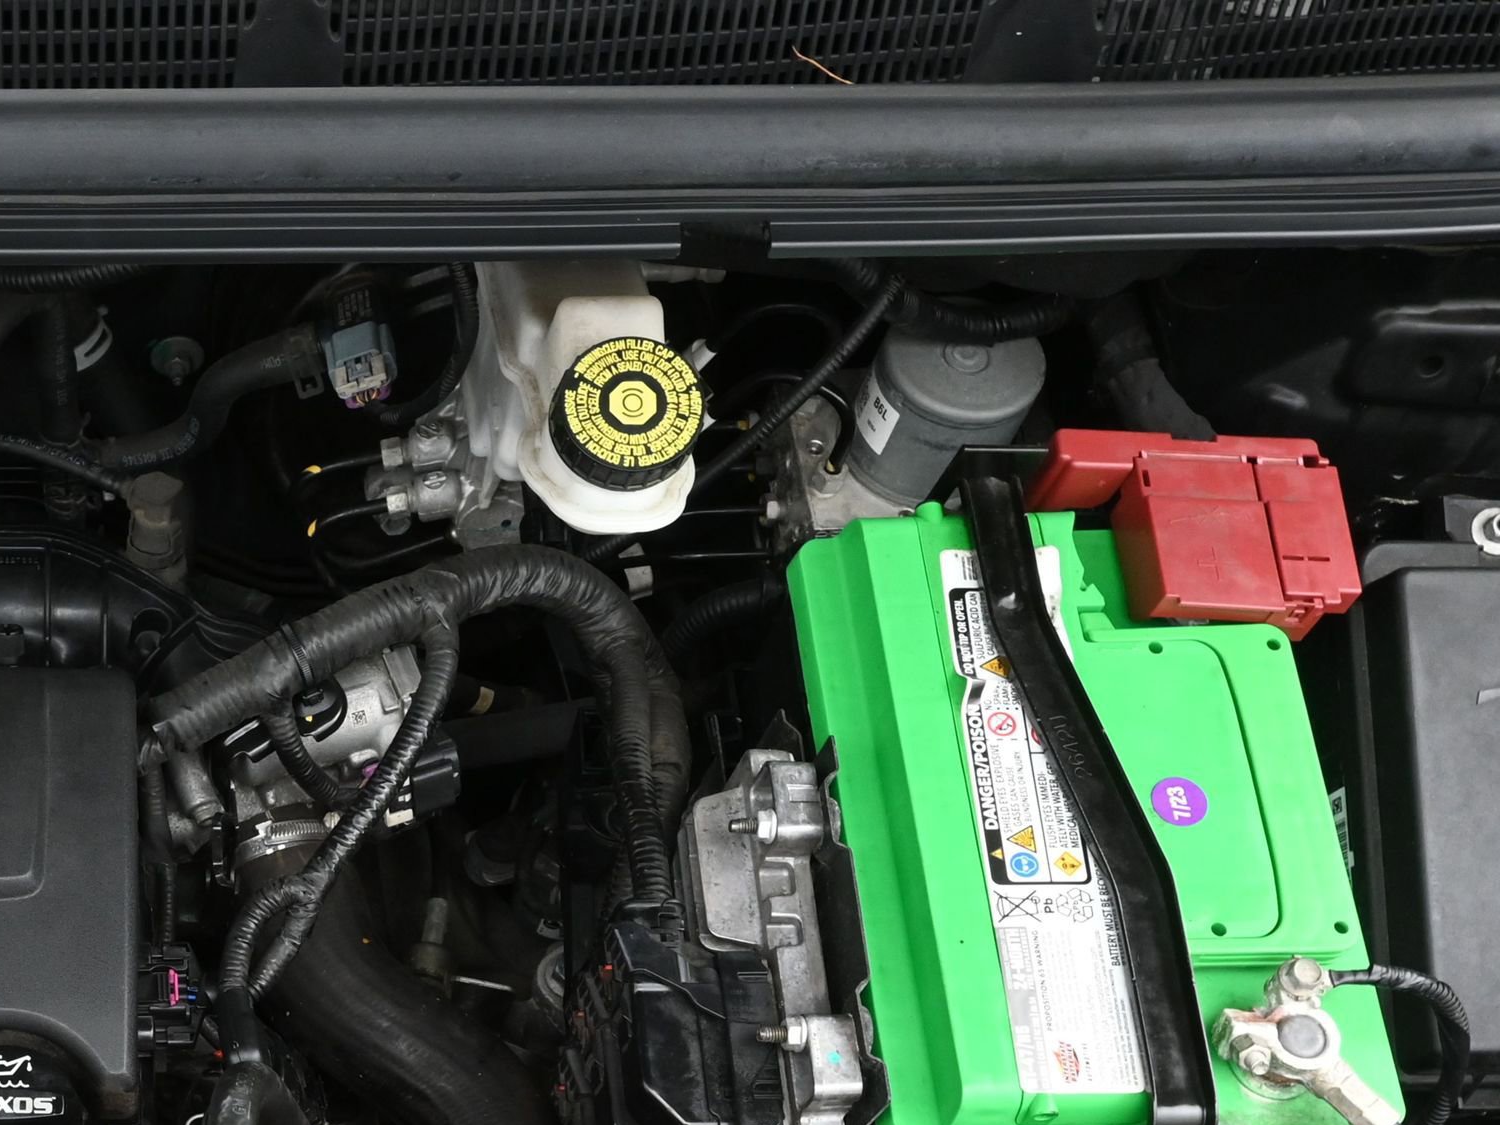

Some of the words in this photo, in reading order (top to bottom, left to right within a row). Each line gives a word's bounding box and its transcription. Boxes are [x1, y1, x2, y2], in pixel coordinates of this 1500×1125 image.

[582, 351, 621, 381] REMOVING.
[620, 350, 640, 361] USE
[639, 350, 661, 365] ONLY
[655, 357, 673, 372] DOT
[668, 370, 687, 392] FLUID
[625, 339, 656, 353] FILLER
[653, 343, 675, 361] CAP
[669, 355, 697, 386] BEFORE
[591, 367, 613, 388] FROM
[608, 364, 619, 375] A
[615, 360, 644, 373] SEALED
[575, 380, 591, 408] LIQUIDE
[576, 407, 590, 421] DU
[672, 417, 687, 430] DE
[574, 430, 590, 445] DE
[581, 439, 621, 465] BOUCHON
[622, 455, 635, 466] LE
[955, 598, 965, 620] OPEN.
[969, 593, 978, 605] CAN
[958, 621, 968, 632] OR
[970, 607, 980, 624] ACID
[961, 633, 970, 644] TIP
[973, 625, 985, 659] SULFURIC
[962, 644, 972, 662] NOT
[965, 663, 974, 674] DO
[984, 700, 991, 710] NO
[969, 704, 999, 830] DANGER/POISON
[991, 745, 1004, 782] EXPLOSIVE
[1015, 751, 1025, 774] INJURY
[1007, 767, 1016, 785] CAUSE
[1019, 776, 1027, 785] OR
[1038, 771, 1050, 802] IMMEDI-
[998, 788, 1008, 803] EYES
[1009, 787, 1018, 800] CAN
[1021, 788, 1031, 821] BLINDNESS
[1166, 785, 1192, 821] 7/23
[1000, 807, 1012, 832] SHIELD
[1011, 802, 1021, 826] GASES
[1041, 805, 1054, 821] EYES
[1055, 805, 1064, 824] WITH
[1046, 824, 1057, 847] FLUSH
[1056, 826, 1068, 847] ATELY
[1068, 815, 1079, 847] MEDICAL
[1045, 898, 1054, 913] Pb
[1100, 897, 1111, 907] BE
[1103, 909, 1114, 931] MUST
[1032, 930, 1042, 966] WARNING
[1107, 933, 1121, 965] BATTERY
[1039, 968, 1046, 977] 65
[1041, 980, 1052, 1031] PROPOSITION
[1059, 1041, 1070, 1083] INTERSTATE
[1067, 1044, 1077, 1081] BATTERIES
